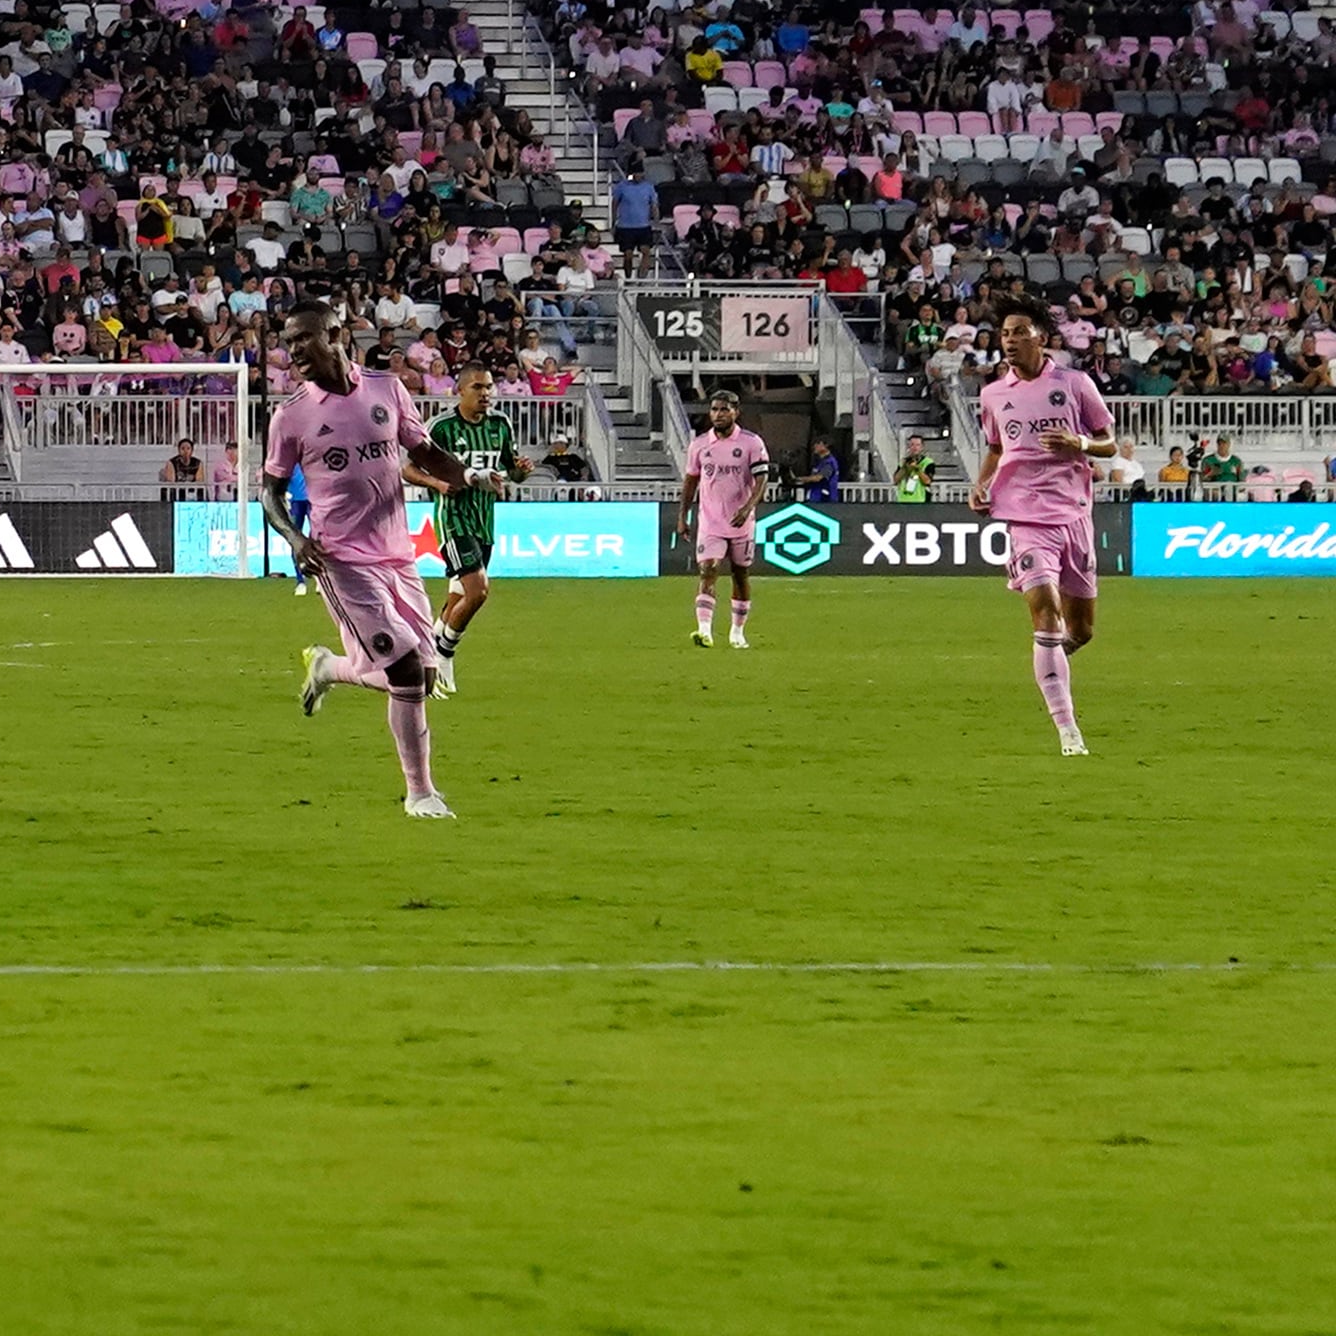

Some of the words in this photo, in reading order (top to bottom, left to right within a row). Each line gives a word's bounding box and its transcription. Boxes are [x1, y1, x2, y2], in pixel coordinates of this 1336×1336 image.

[653, 310, 705, 338] 125
[741, 312, 791, 338] 126
[500, 534, 625, 557] ILVER
[862, 521, 1011, 566] XBTO
